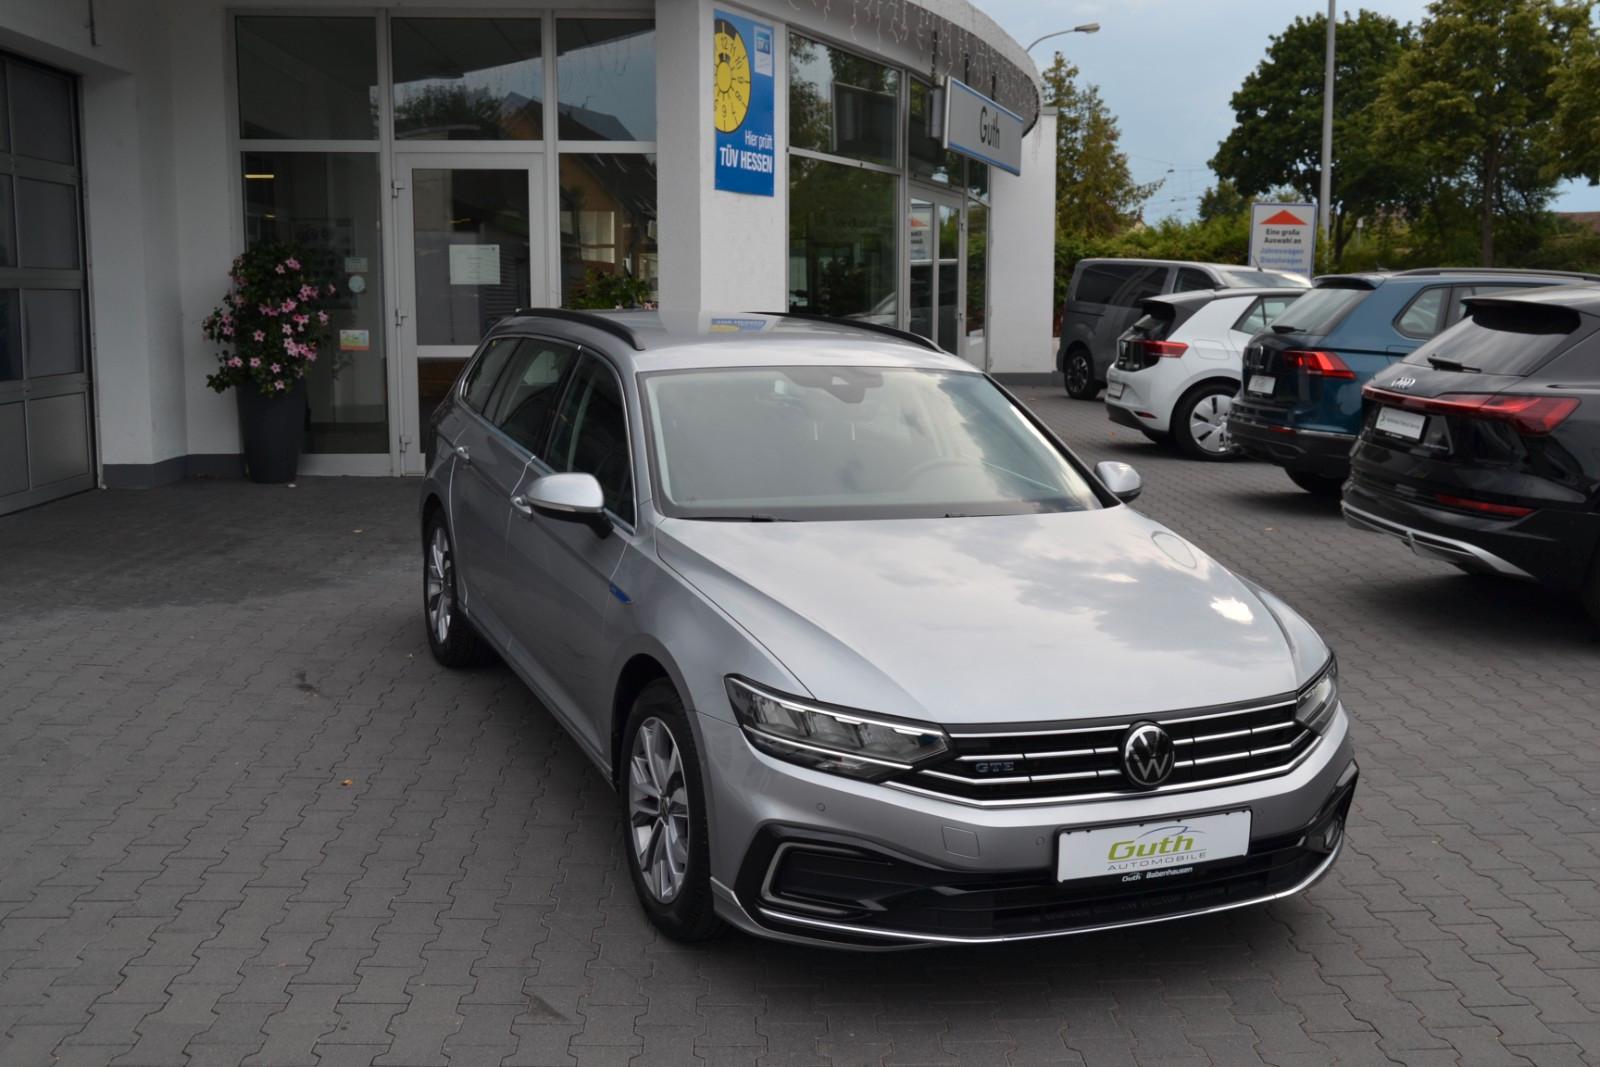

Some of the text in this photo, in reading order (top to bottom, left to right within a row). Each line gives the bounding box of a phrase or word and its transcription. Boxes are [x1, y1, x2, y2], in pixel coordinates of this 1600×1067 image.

[980, 105, 1000, 150] Guth
[745, 129, 772, 150] Hier prüft
[720, 144, 772, 173] TÜV HESSEN
[975, 761, 1015, 773] GTE
[1107, 834, 1194, 862] Guth
[1107, 851, 1207, 872] AUTOMOBILE
[1121, 866, 1193, 883] Guth Babenhausen
